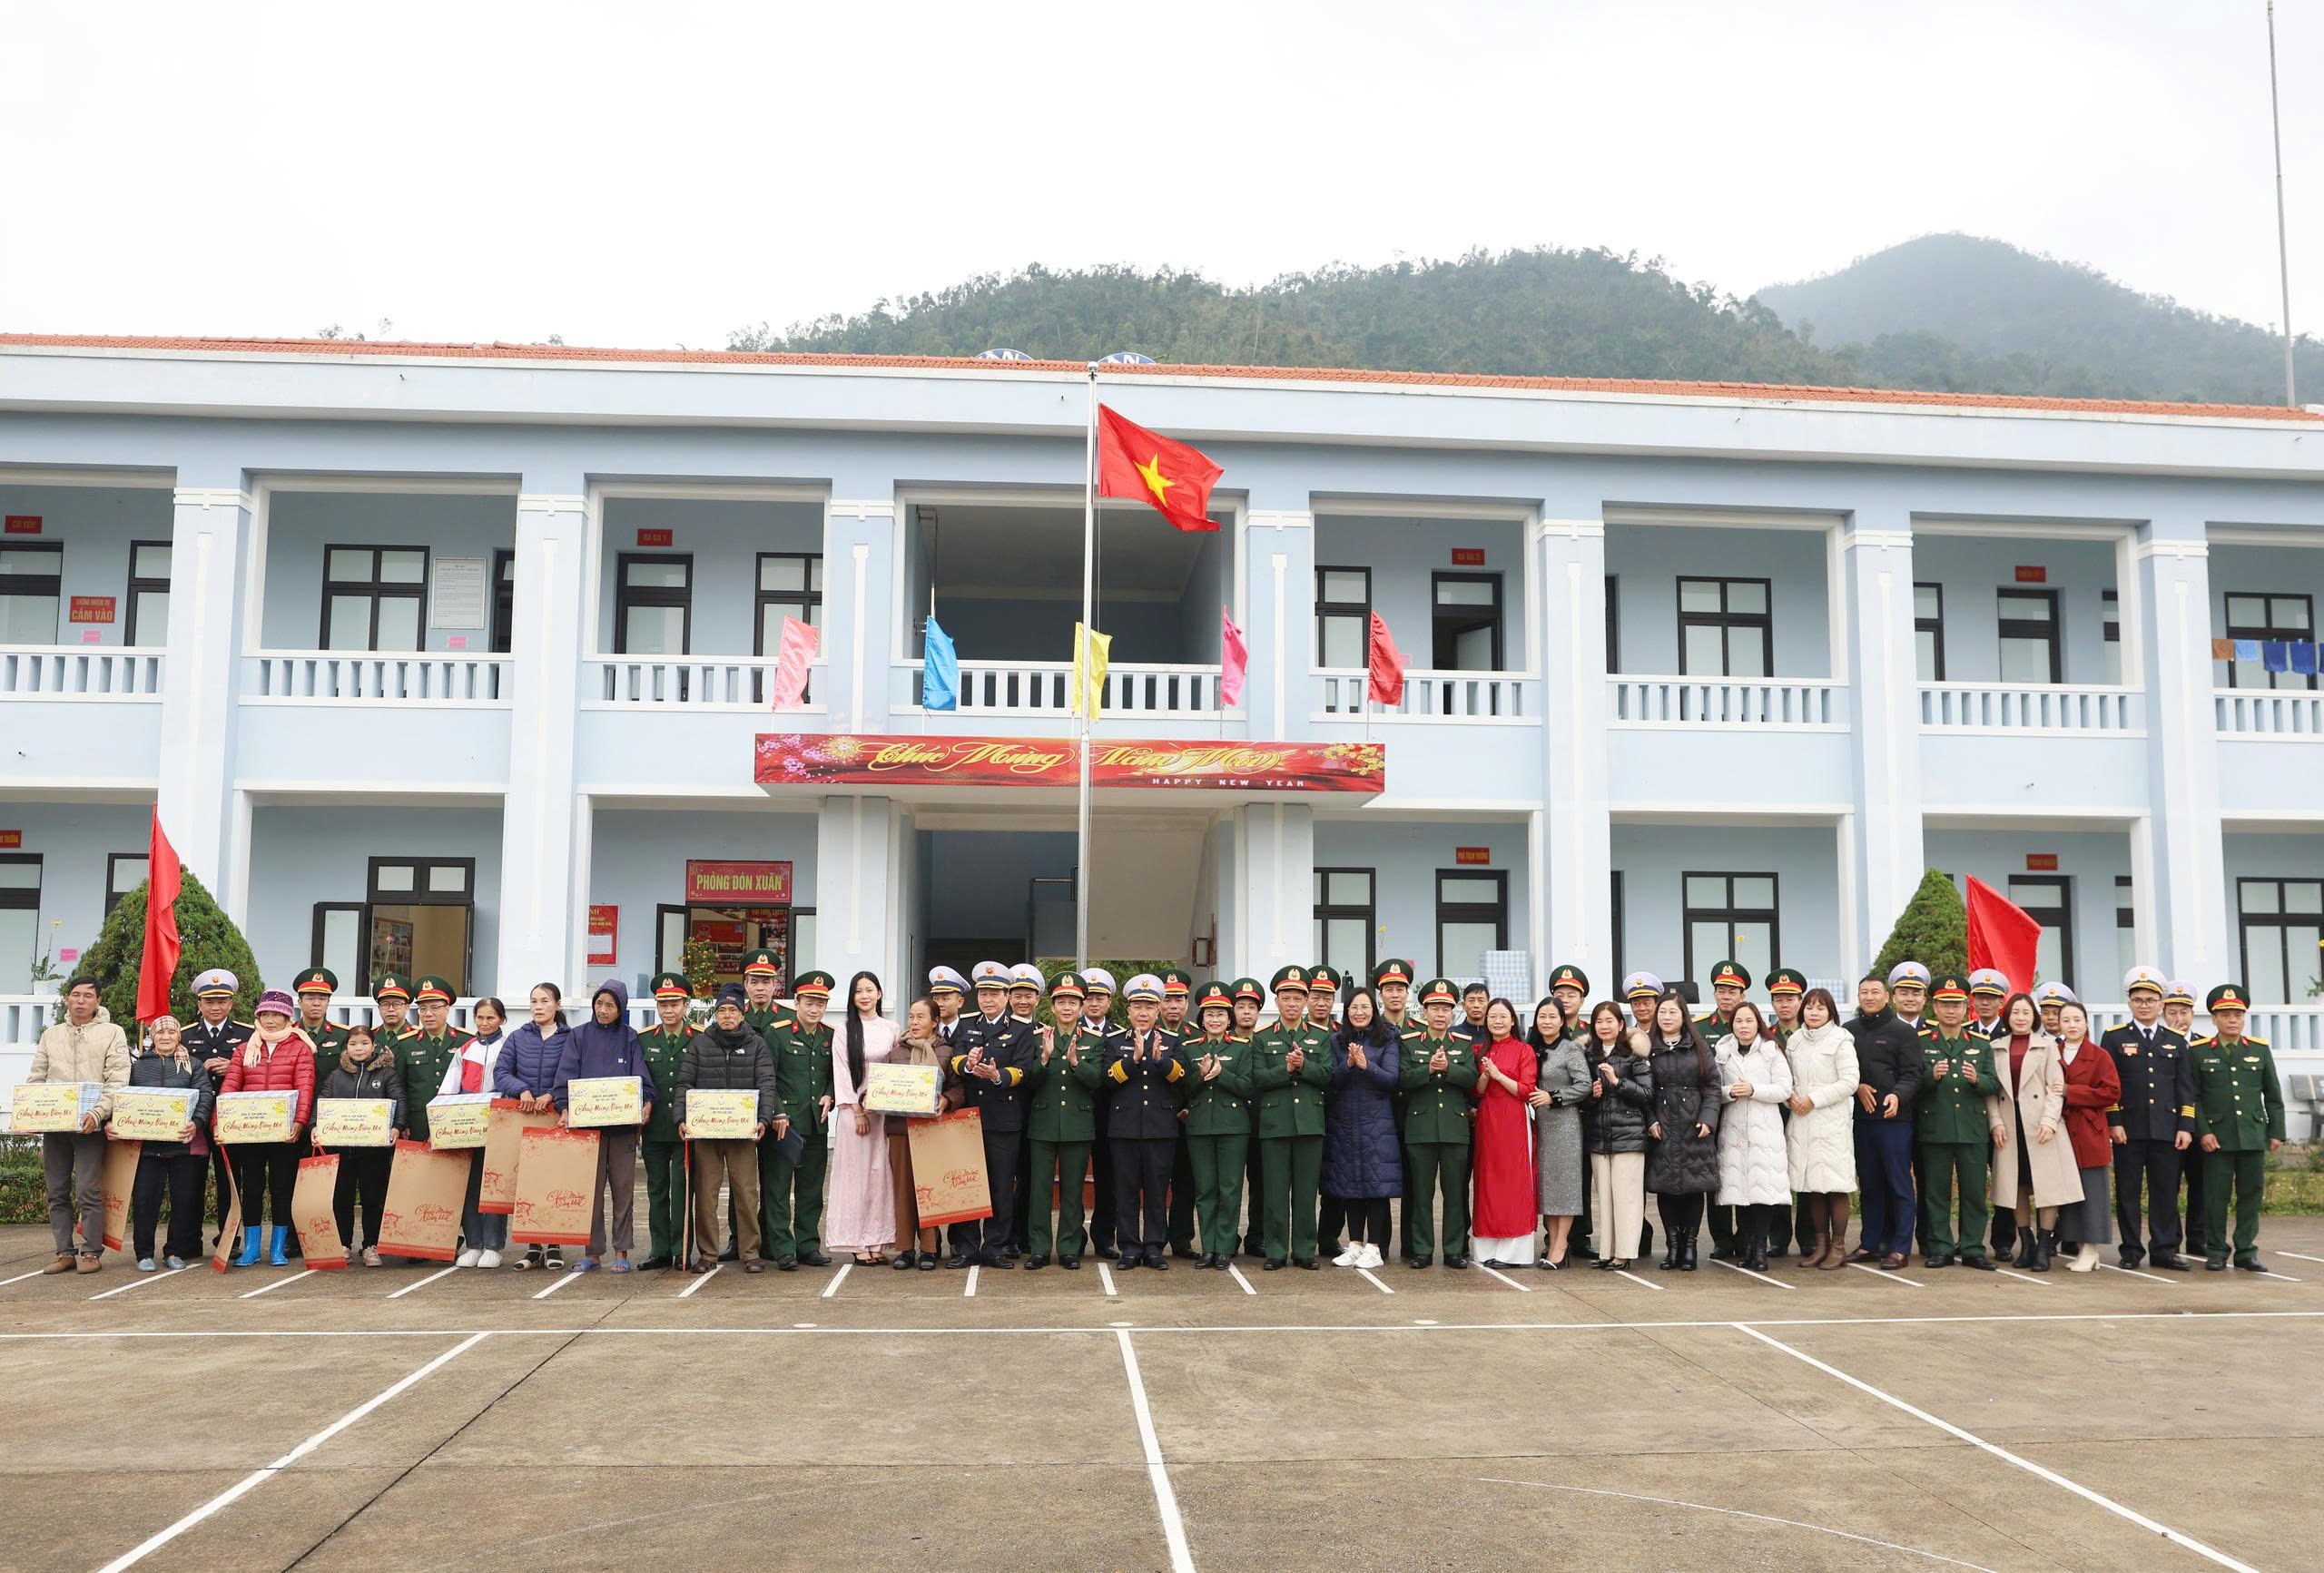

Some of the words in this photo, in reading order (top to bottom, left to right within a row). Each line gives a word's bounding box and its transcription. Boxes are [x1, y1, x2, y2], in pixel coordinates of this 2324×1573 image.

[72, 607, 93, 621] CẤM
[95, 609, 113, 621] VÀO
[856, 742, 950, 771] Chúc
[923, 742, 1075, 774] Mừng
[696, 871, 730, 890] PHÒNG
[732, 871, 753, 890] ĐÓN
[754, 872, 782, 891] XUÂN
